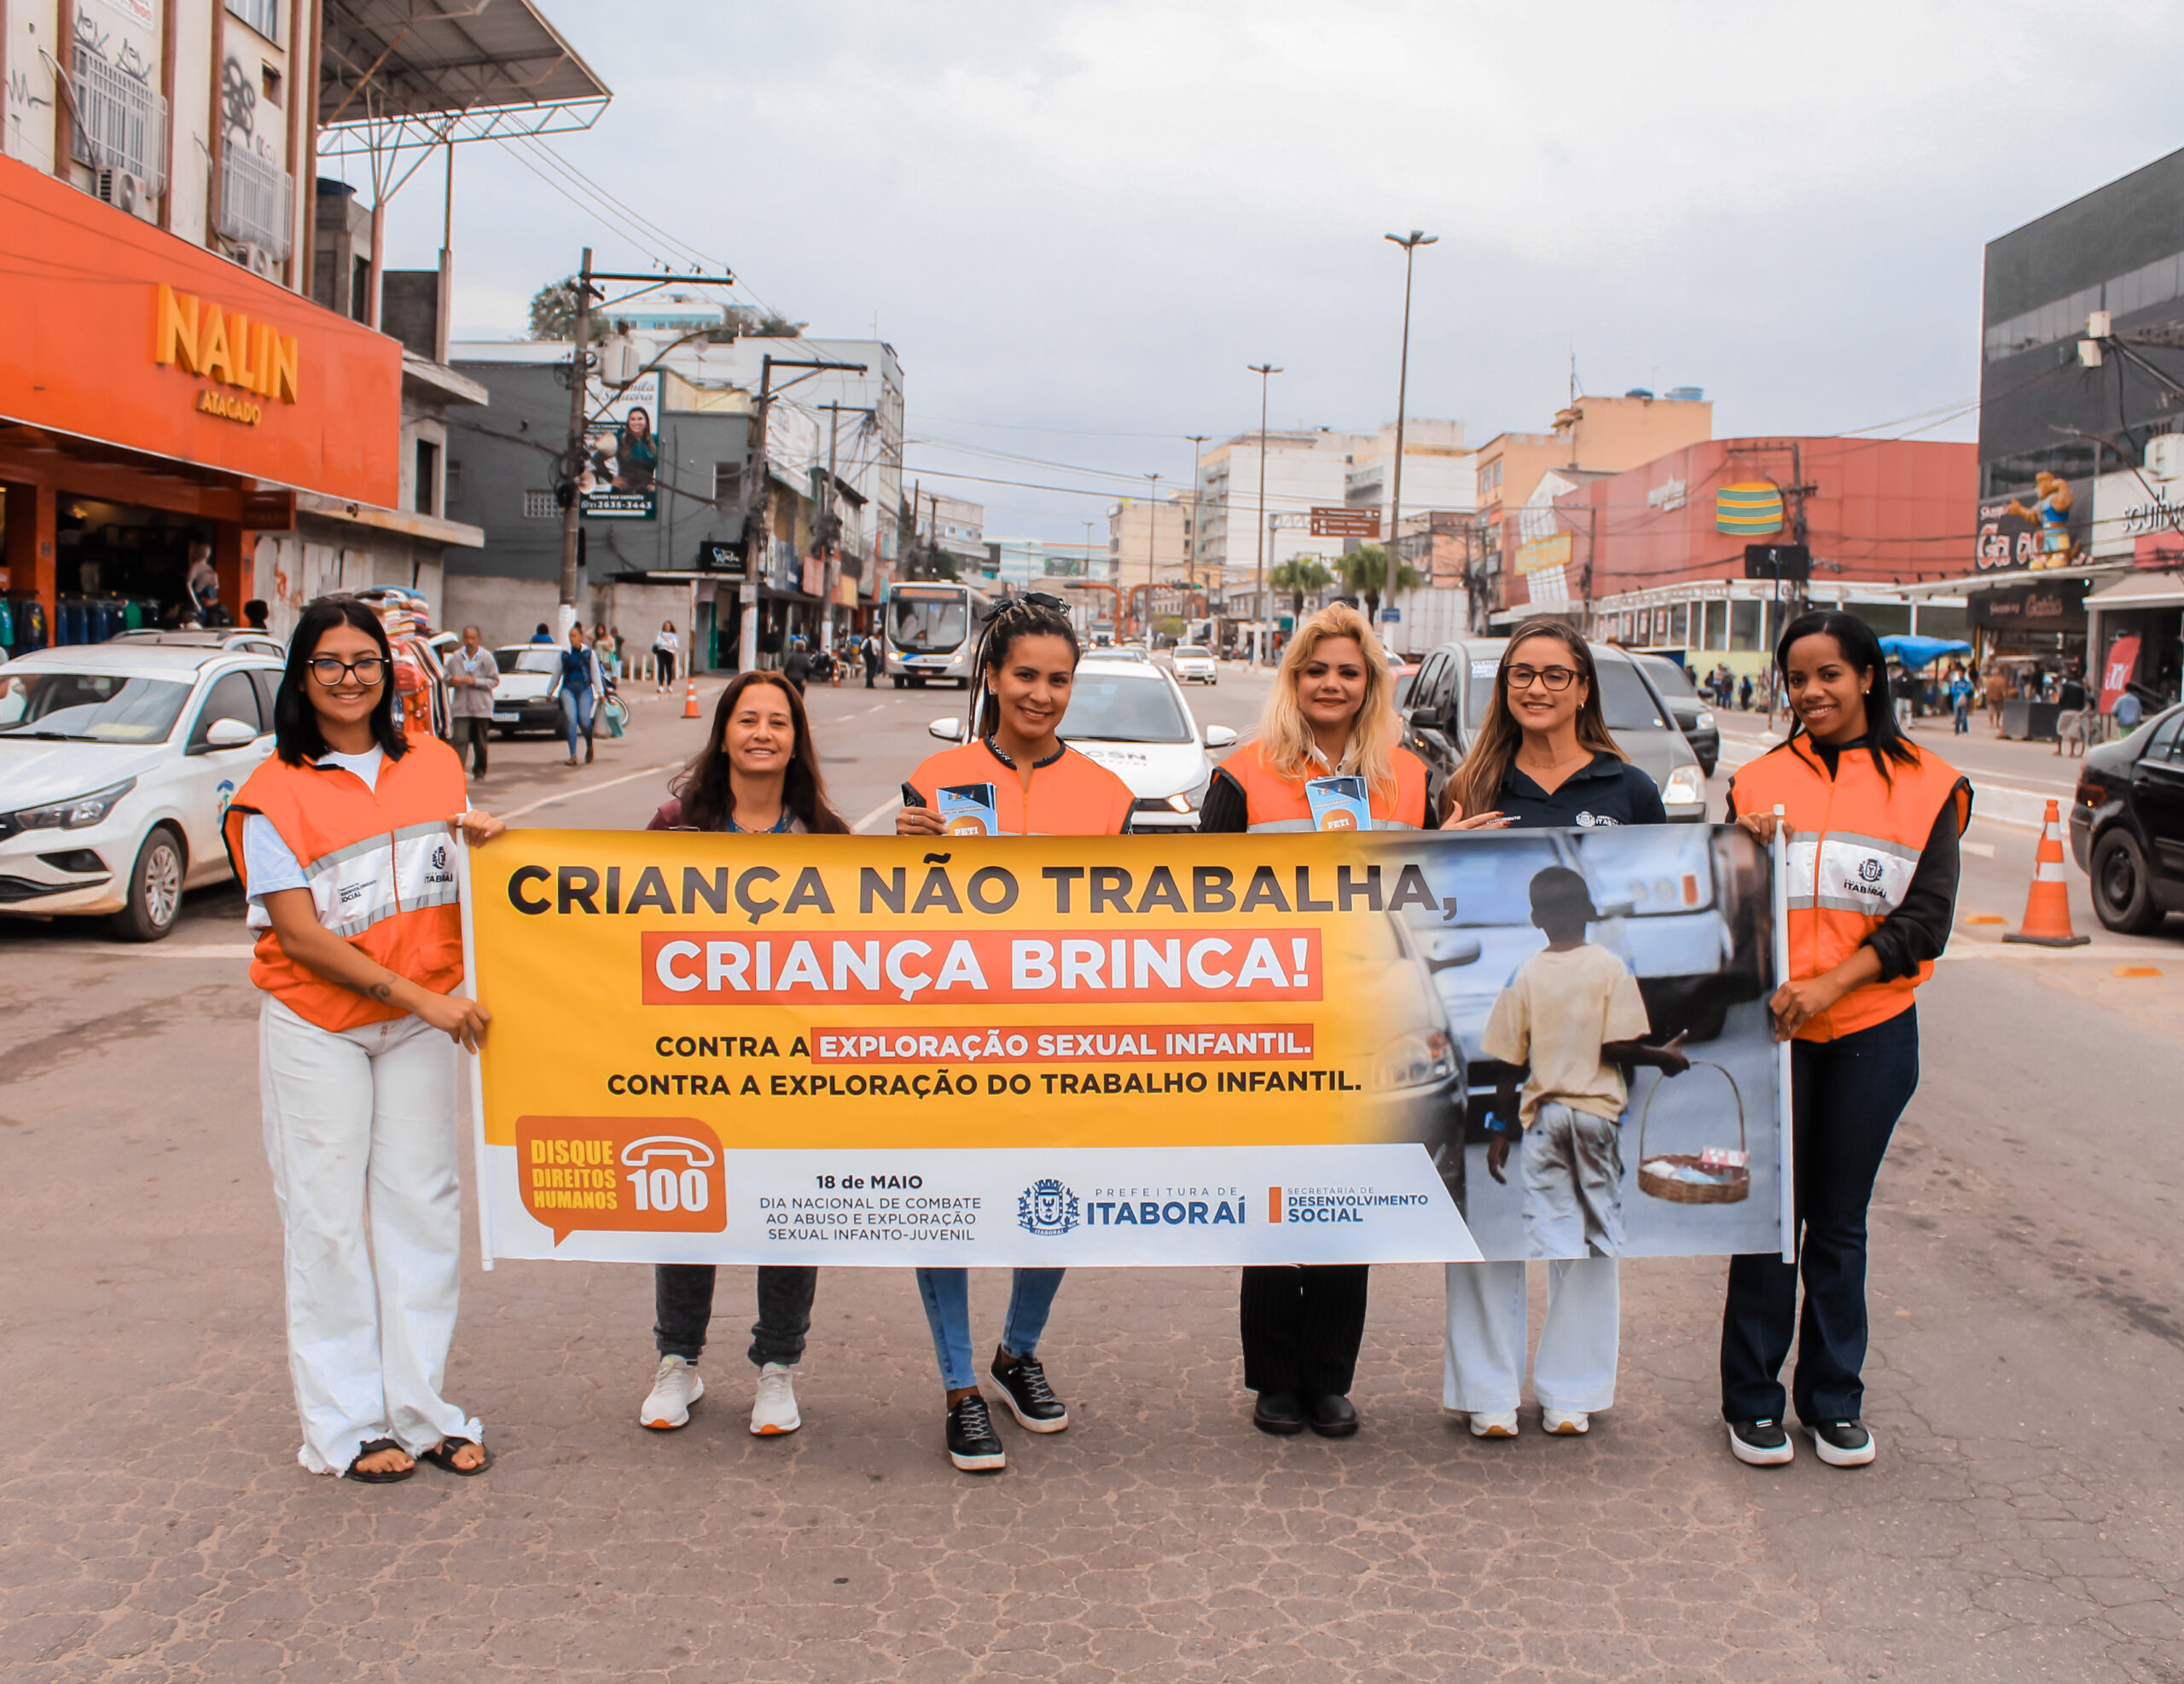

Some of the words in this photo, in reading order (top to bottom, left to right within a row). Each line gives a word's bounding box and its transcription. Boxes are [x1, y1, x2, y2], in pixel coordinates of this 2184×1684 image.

[154, 283, 298, 405] NALIN
[199, 390, 261, 426] ATACADO
[954, 826, 979, 835] PETI
[1327, 818, 1350, 829] PETI
[507, 864, 835, 926] CRIANÇA
[860, 852, 1019, 915] NÃO
[1042, 863, 1458, 921] TRABALHA,
[655, 938, 989, 1002] CRIANÇA
[1011, 937, 1310, 990] BRINCA!
[655, 1036, 780, 1058] CONTRA
[789, 1036, 810, 1058] A
[819, 1029, 1029, 1062] EXPLORAÇÃO
[1037, 1033, 1157, 1058] SEXUAL
[1166, 1031, 1311, 1055] INFANTIL.
[607, 1074, 731, 1096] CONTRA
[740, 1075, 761, 1096] A
[770, 1068, 978, 1100] EXPLORAÇÃO
[987, 1073, 1031, 1095] DO
[1041, 1071, 1207, 1095] TRABALHO
[1217, 1070, 1362, 1093] INFANTIL.
[530, 1139, 614, 1167] DISQUE
[531, 1168, 617, 1189] DIREITOS
[626, 1168, 709, 1211] 100
[816, 1175, 836, 1189] 18
[841, 1175, 865, 1189] de
[870, 1175, 923, 1189] MAIO
[1095, 1187, 1210, 1197] PREFEITURA
[1217, 1187, 1237, 1196] DE
[533, 1190, 618, 1211] HUMANOS
[759, 1197, 787, 1209] DIA
[792, 1197, 874, 1209] NACIONAL
[880, 1197, 900, 1209] DE
[905, 1197, 981, 1209] COMBATE
[1087, 1195, 1246, 1225] ITABORAÍ
[1288, 1194, 1428, 1207] DESENVOLVIMENTO
[766, 1213, 788, 1224] AO
[793, 1213, 848, 1224] ABUSO
[853, 1213, 863, 1224] E
[868, 1211, 976, 1226] EXPLORAÇÃO
[1288, 1208, 1363, 1222] SOCIAL
[768, 1228, 828, 1240] SEXUAL
[834, 1228, 975, 1240] INFANTO-JUVENIL
